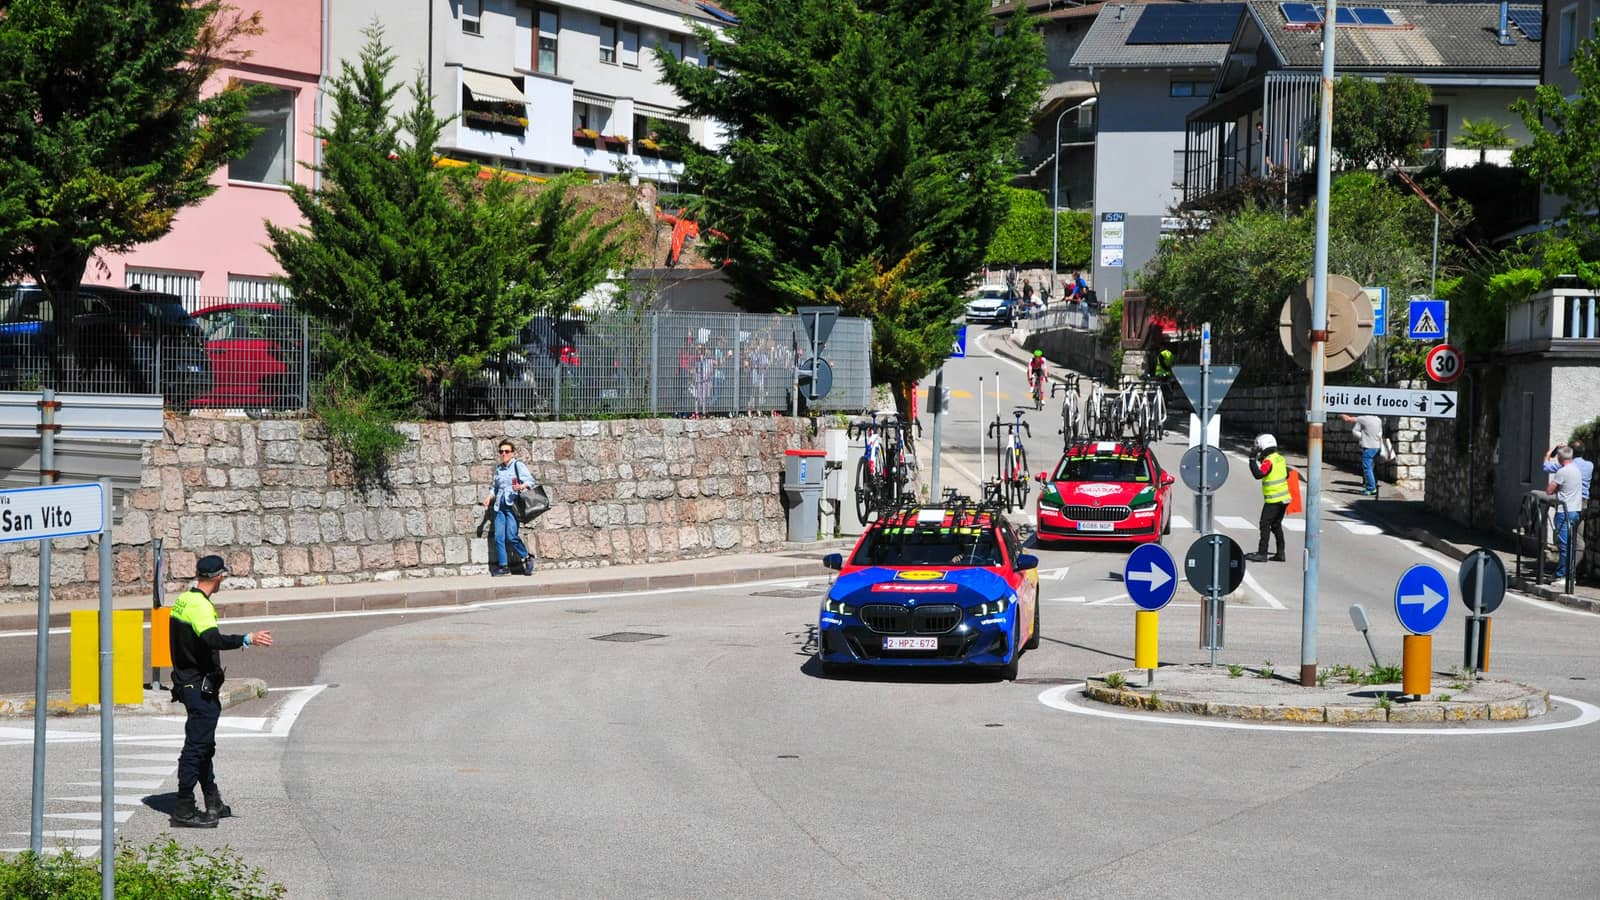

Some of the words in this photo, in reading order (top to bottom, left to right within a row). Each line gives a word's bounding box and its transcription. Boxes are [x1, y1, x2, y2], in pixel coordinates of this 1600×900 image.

[1436, 355, 1455, 372] 30
[1354, 394, 1371, 406] del
[1377, 395, 1408, 408] fuoco
[0, 496, 10, 504] Via
[2, 509, 32, 532] San
[41, 505, 72, 528] Vito
[888, 639, 936, 648] 2-HPZ-672
